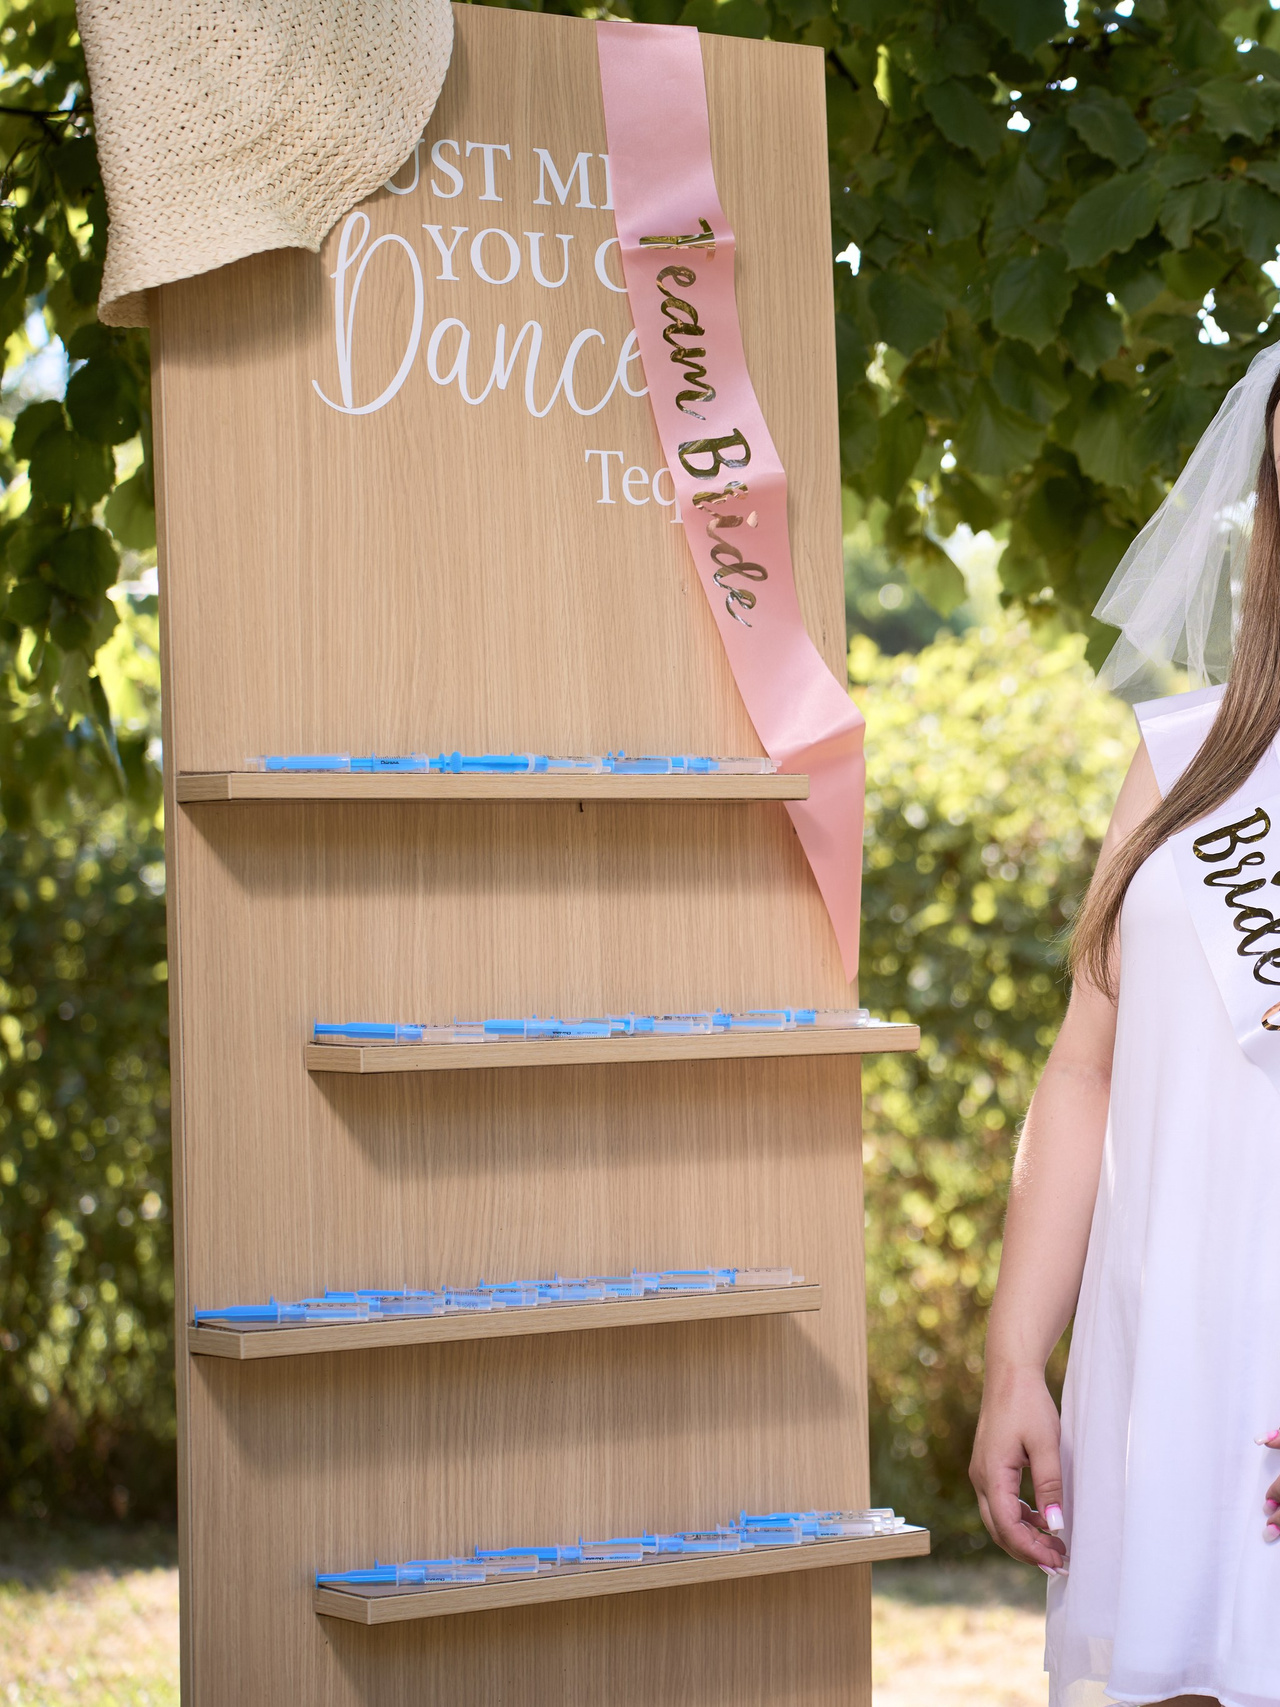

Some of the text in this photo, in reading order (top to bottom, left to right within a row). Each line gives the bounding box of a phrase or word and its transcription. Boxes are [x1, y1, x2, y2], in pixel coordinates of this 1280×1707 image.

[312, 211, 650, 418] Dance
[422, 223, 574, 288] YOU
[639, 217, 768, 627] Team Bride
